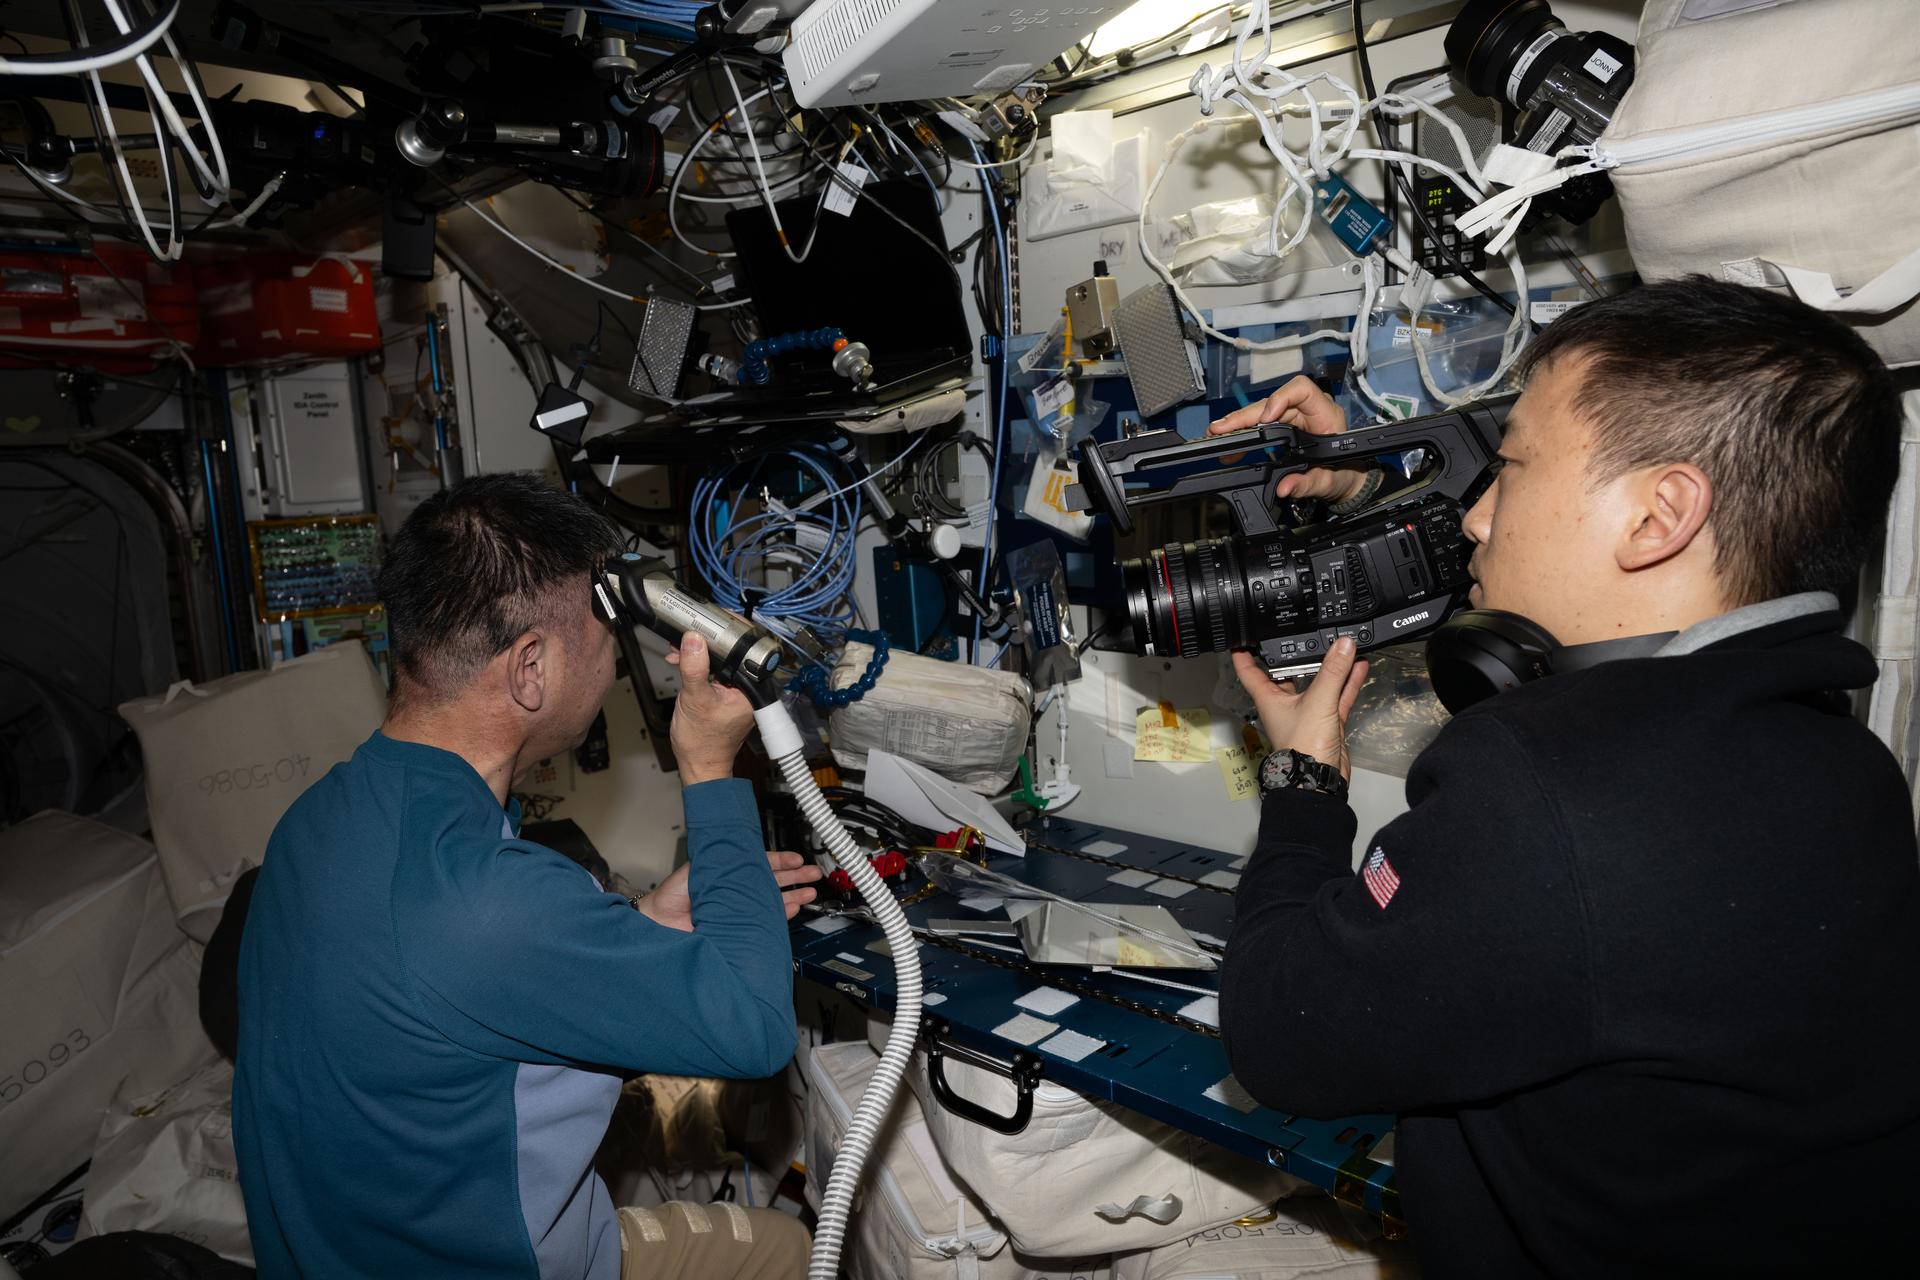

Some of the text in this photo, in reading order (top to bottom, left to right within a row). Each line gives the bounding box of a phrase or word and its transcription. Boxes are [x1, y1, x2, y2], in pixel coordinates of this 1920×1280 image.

[1590, 56, 1615, 76] JONNY
[1428, 189, 1442, 198] 2TG
[1428, 198, 1442, 206] PTT
[1101, 240, 1125, 257] DRY
[302, 391, 328, 400] Zenith
[310, 401, 339, 409] Control
[307, 411, 329, 419] Panel
[1392, 610, 1429, 628] Canon
[198, 754, 311, 797] 40-5086
[0, 1028, 90, 1103] 5093
